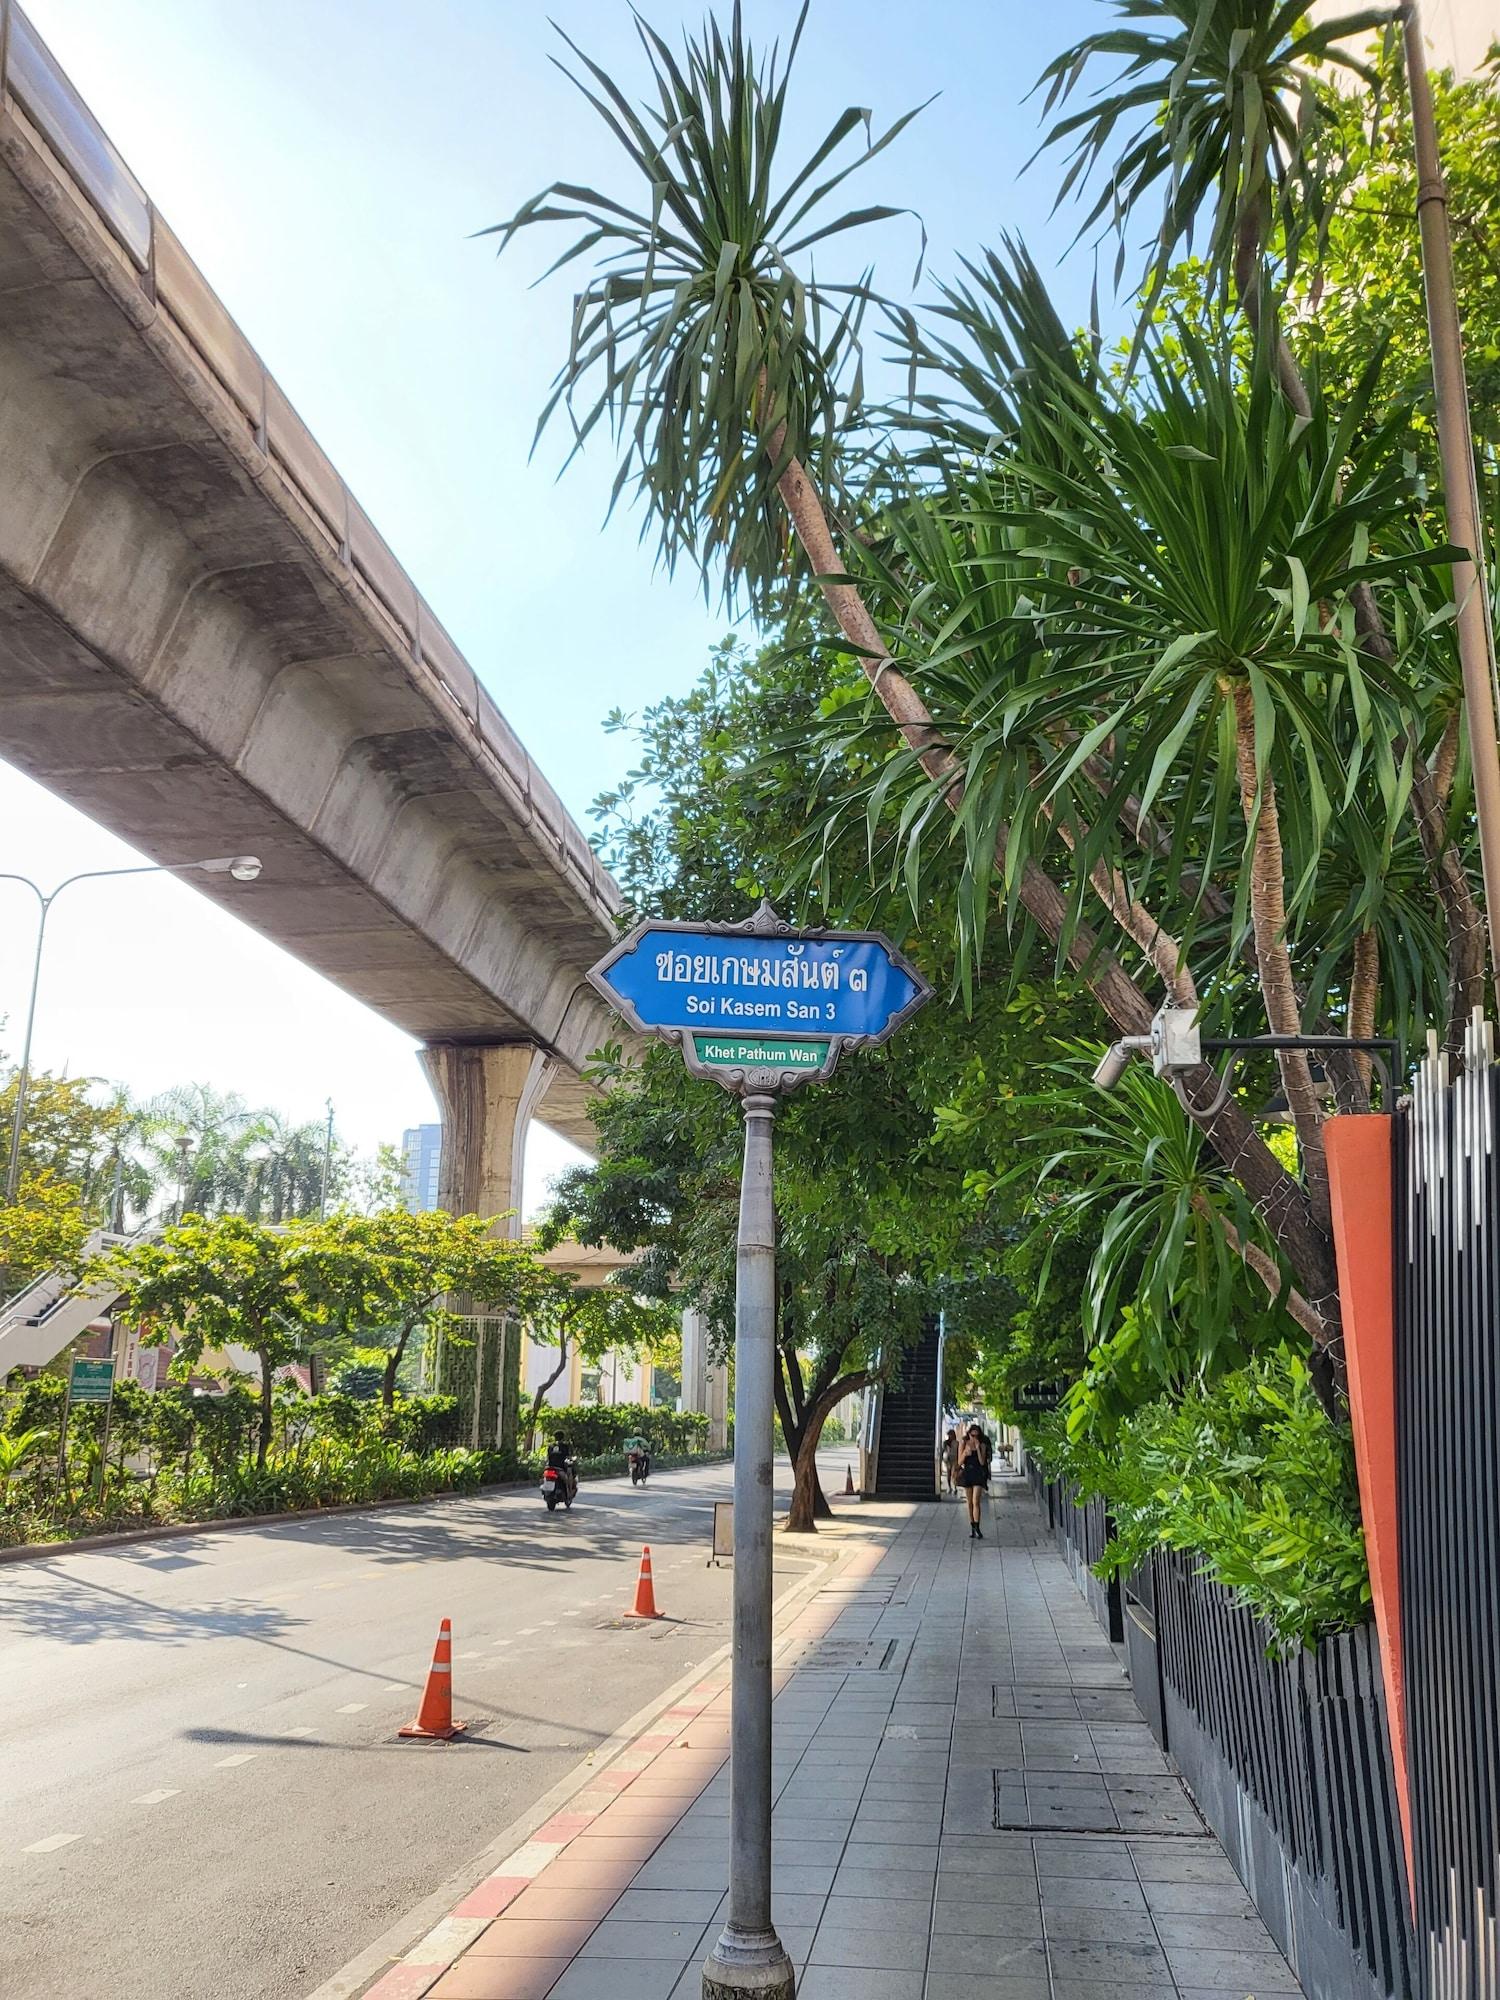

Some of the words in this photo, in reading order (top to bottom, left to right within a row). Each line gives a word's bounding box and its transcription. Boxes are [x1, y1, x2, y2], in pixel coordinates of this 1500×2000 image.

[656, 944, 844, 990] ซอยเกษมสันต์
[686, 995, 715, 1014] Soi
[720, 997, 781, 1017] Kasem
[786, 1000, 820, 1019] San
[825, 1003, 836, 1020] 3
[705, 1045, 735, 1059] Khet
[738, 1047, 786, 1061] Pathum
[789, 1049, 818, 1062] Wan
